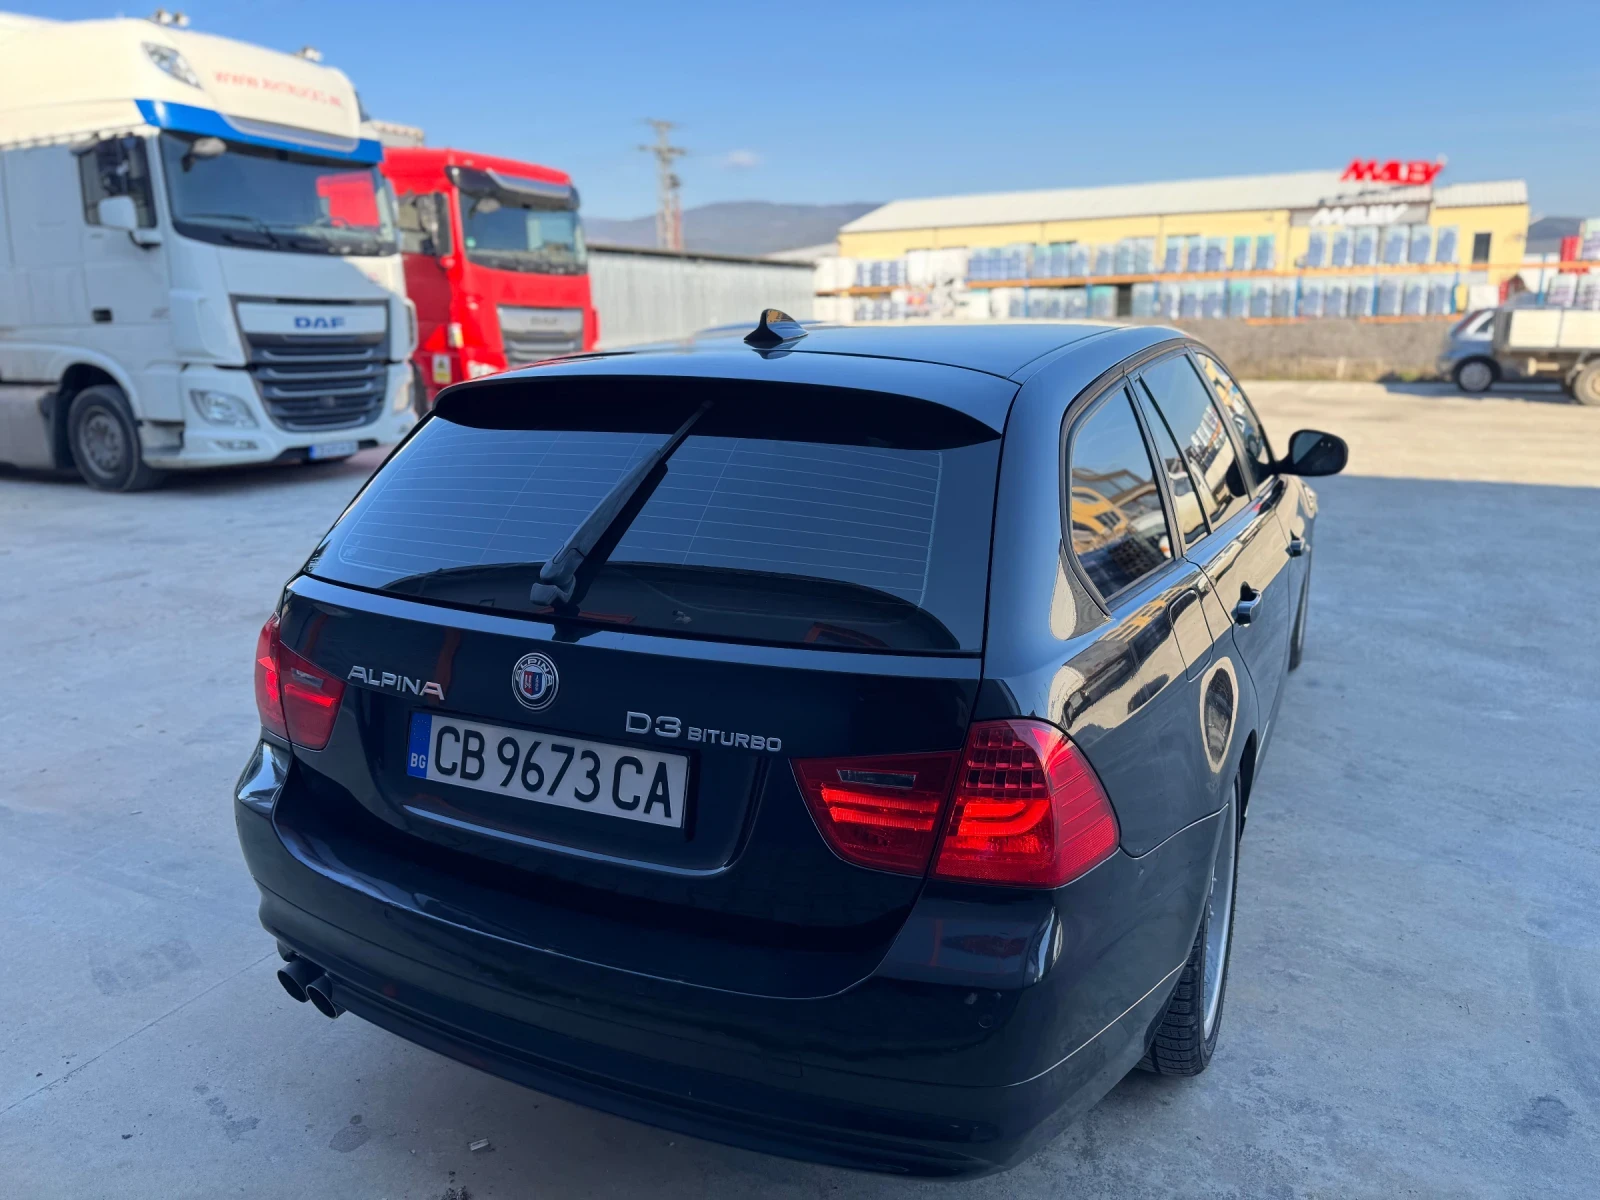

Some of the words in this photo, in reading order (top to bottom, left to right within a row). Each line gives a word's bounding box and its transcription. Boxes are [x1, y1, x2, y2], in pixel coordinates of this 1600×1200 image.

[294, 315, 346, 329] DAF
[347, 665, 445, 700] ALPINA
[515, 658, 553, 687] ALPINA
[625, 710, 682, 738] D3
[687, 726, 782, 752] BITURBO
[410, 752, 426, 769] BG
[434, 725, 485, 781] CB
[497, 736, 601, 802] 9673
[612, 755, 672, 818] CA
